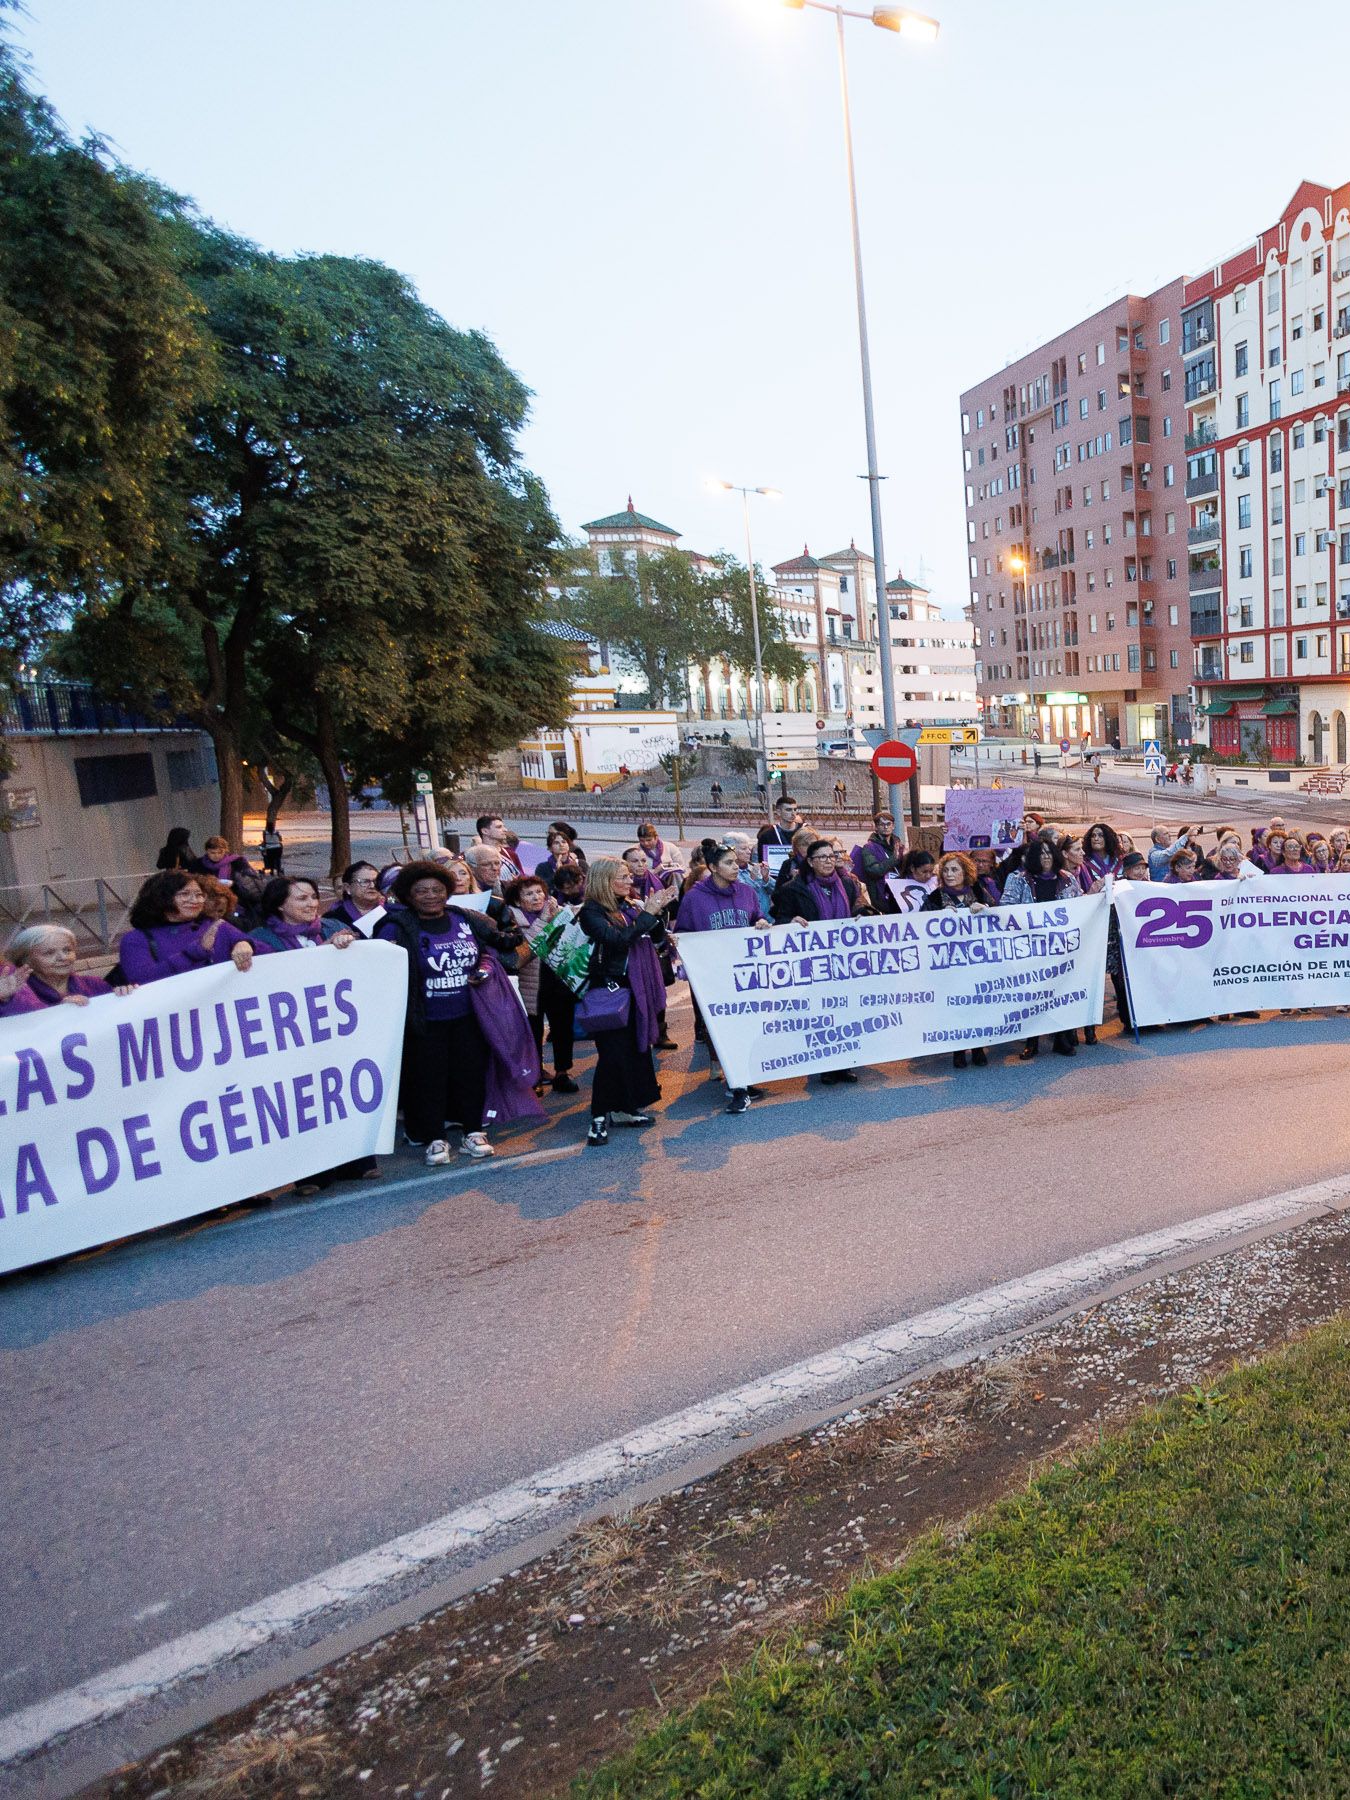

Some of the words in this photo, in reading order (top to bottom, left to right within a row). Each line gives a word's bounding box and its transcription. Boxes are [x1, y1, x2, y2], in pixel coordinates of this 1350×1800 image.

[1236, 894, 1334, 904] INTERNACIONAL
[744, 921, 919, 958] PLATAFORMA
[925, 912, 1022, 938] CONTRA
[1027, 907, 1069, 929] LAS
[1134, 897, 1214, 949] 25
[427, 952, 476, 971] Vivas
[733, 947, 920, 992] VIOLENCIAS
[928, 927, 1081, 970] MACHISTAS
[1213, 960, 1302, 977] ASOCIACIÓN
[1308, 961, 1328, 970] DE
[975, 960, 1074, 995] DENUNCIA
[1213, 976, 1249, 986] MANOS
[1253, 974, 1304, 982] ABIERTAS
[1308, 970, 1340, 979] HACIA
[822, 996, 848, 1009] DE
[860, 991, 934, 1007] GENERO
[947, 989, 1055, 1006] SOLIDARIDAD
[1004, 988, 1087, 1024] LIBERTAD
[763, 1014, 834, 1034] GRUPO
[805, 1010, 903, 1048] ACCION
[923, 1023, 1022, 1043] FORTALEZA
[0, 1032, 95, 1116] AS
[117, 978, 358, 1087] MUJERES
[761, 1040, 861, 1072] SORORIDAD
[76, 1114, 162, 1195] DE
[179, 1058, 384, 1163] GÉNERO
